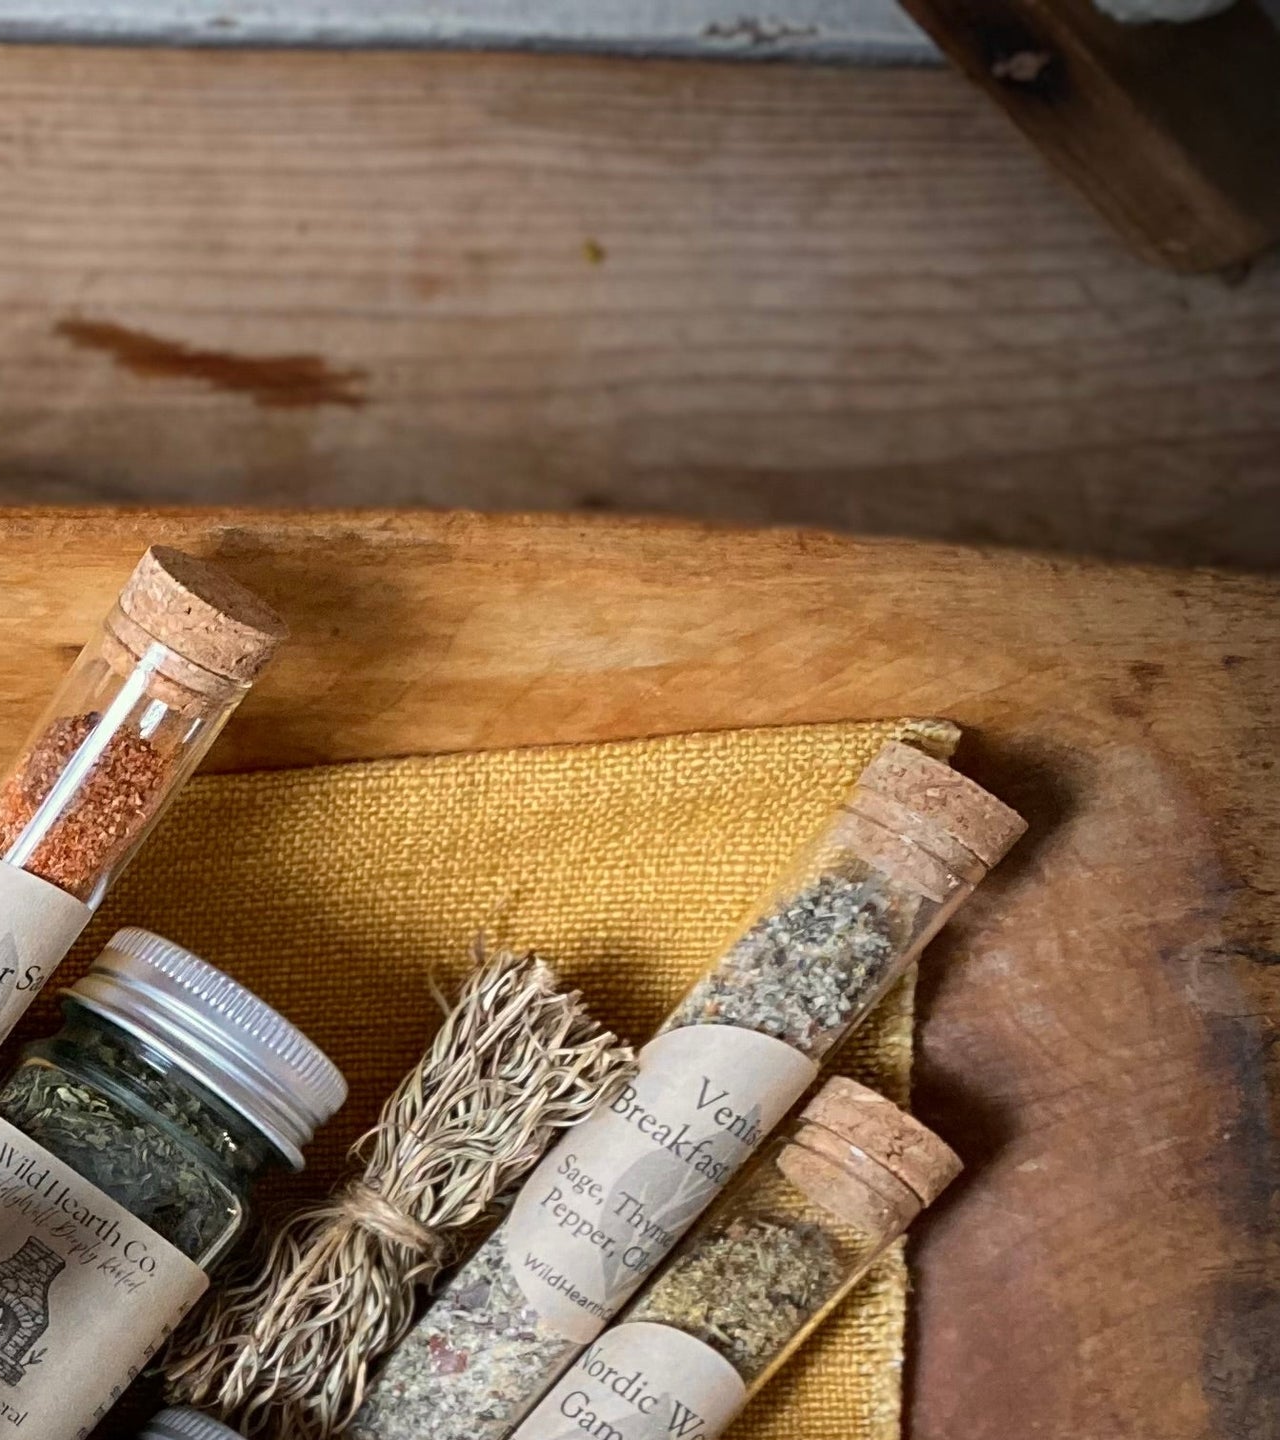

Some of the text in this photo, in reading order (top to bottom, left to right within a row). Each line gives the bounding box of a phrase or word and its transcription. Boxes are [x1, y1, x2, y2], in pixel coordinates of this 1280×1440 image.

[611, 1085, 729, 1183] Breakfast
[0, 1142, 156, 1276] Wild Hearth Co.
[557, 1153, 604, 1205] Sage,
[540, 1187, 616, 1258] Pepper,
[577, 1344, 657, 1414] Nordic
